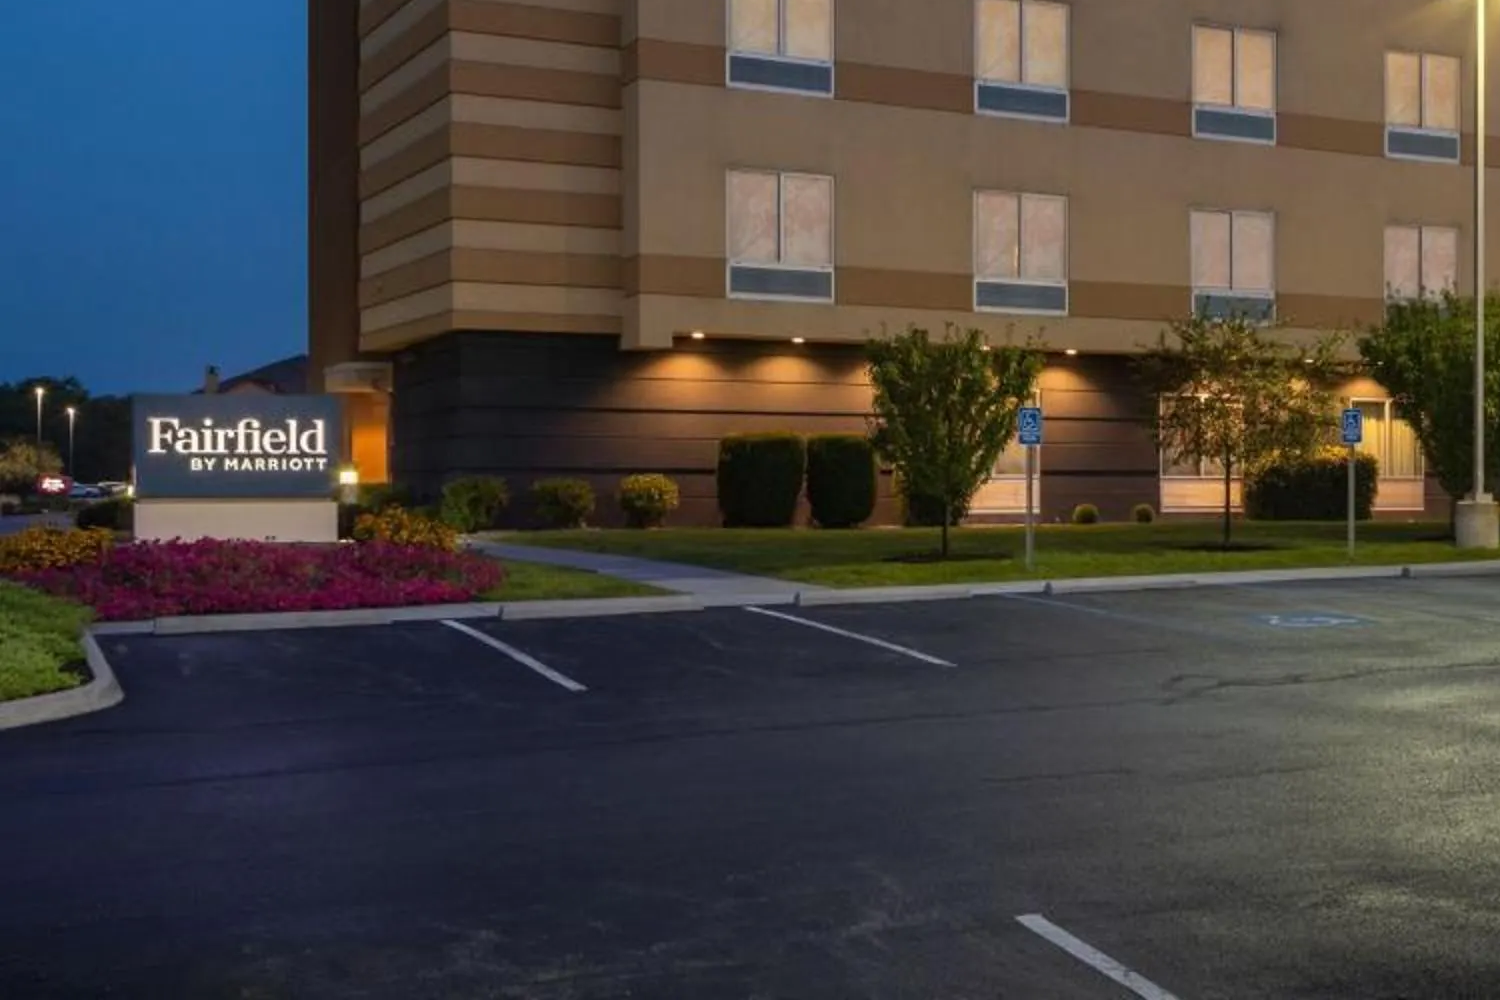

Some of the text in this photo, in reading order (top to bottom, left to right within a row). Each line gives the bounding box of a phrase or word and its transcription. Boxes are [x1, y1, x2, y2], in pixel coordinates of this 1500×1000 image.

[147, 417, 328, 455] Fairfield
[190, 457, 328, 472] BY MARRIOTT
